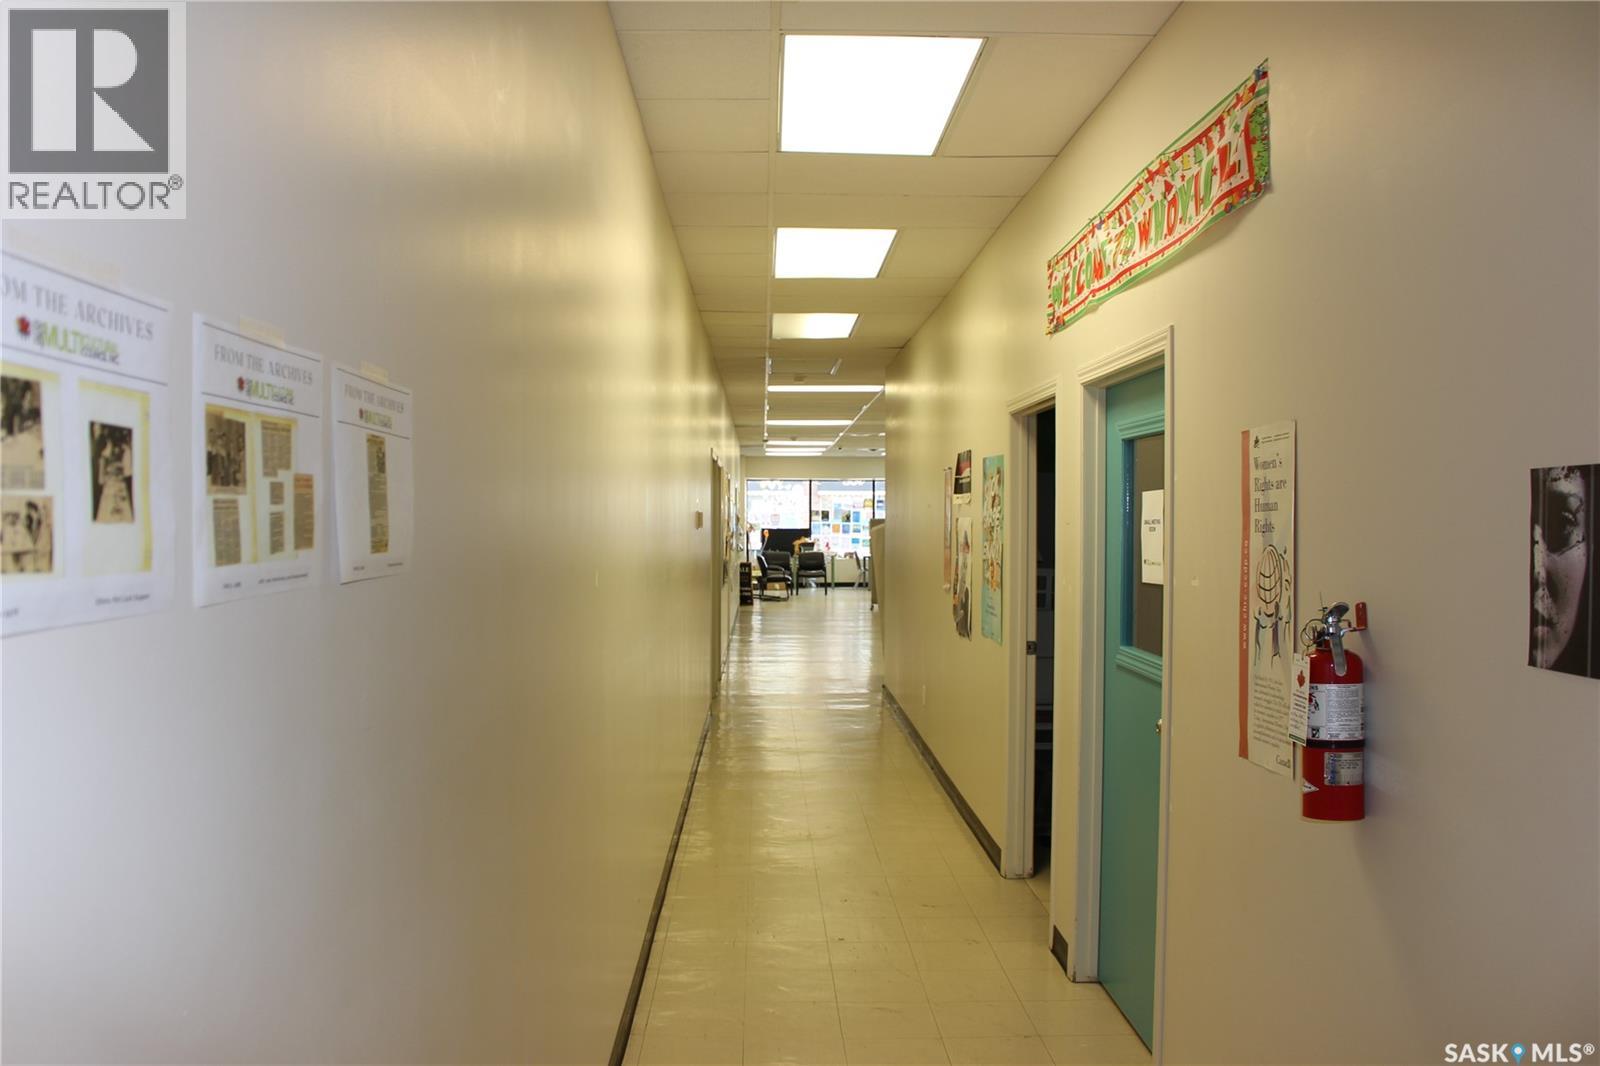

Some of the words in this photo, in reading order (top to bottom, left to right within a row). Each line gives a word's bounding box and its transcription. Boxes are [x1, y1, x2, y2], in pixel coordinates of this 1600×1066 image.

[33, 284, 68, 316] THE
[75, 300, 155, 341] ARCHIVES
[214, 344, 244, 368] FROM
[246, 353, 264, 373] THE
[268, 360, 313, 386] ARCHIVES
[1253, 452, 1283, 470] Women's
[1254, 477, 1274, 496] Rights
[1275, 479, 1288, 490] are
[1254, 498, 1279, 512] Human
[1254, 518, 1276, 537] Rights
